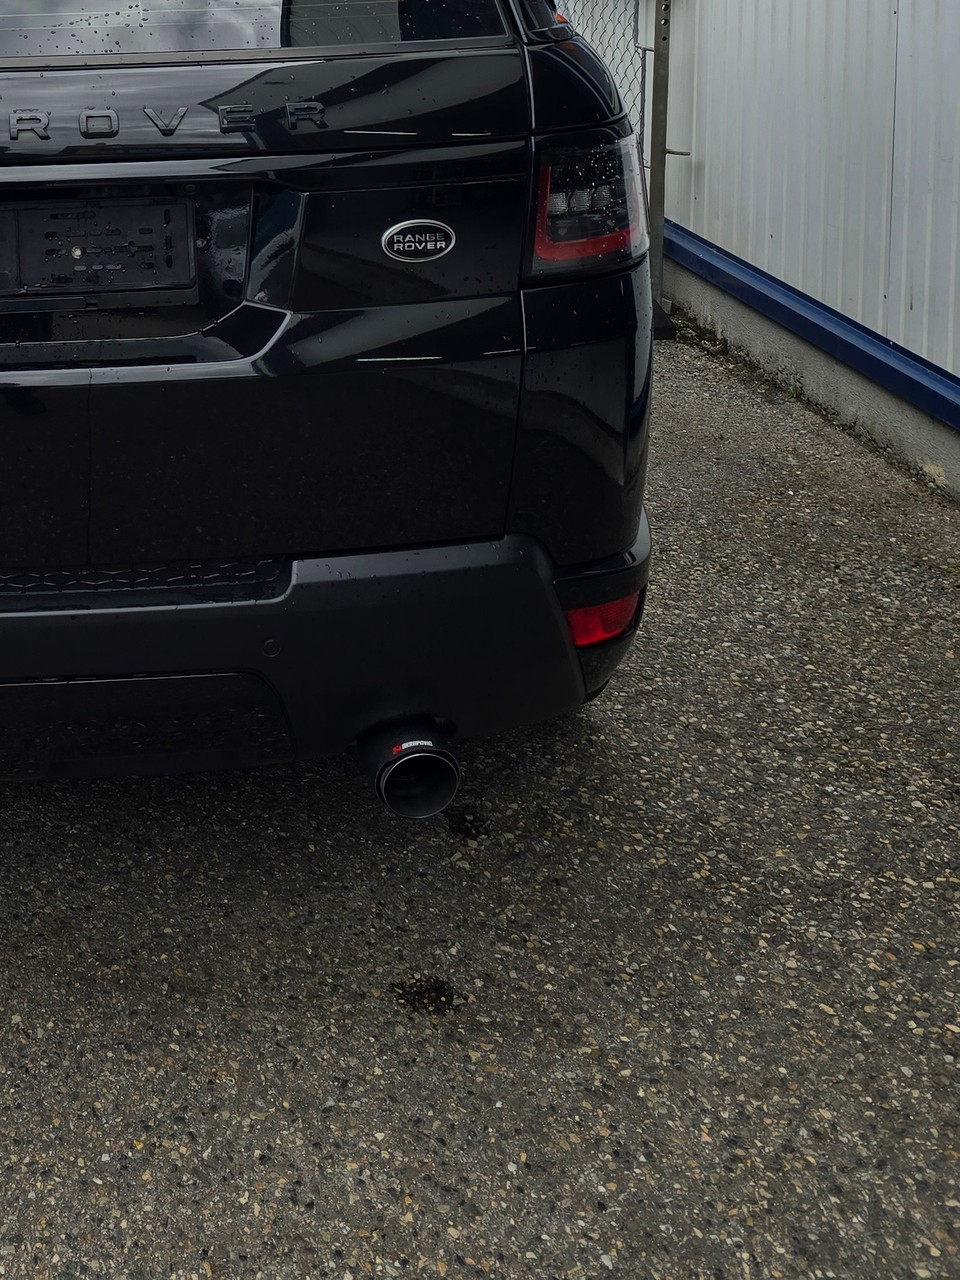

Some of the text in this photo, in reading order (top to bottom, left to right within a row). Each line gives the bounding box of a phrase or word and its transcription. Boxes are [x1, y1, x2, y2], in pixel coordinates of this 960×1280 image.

[8, 101, 330, 142] ROVER
[393, 233, 445, 243] RANGE
[393, 241, 446, 251] ROVER
